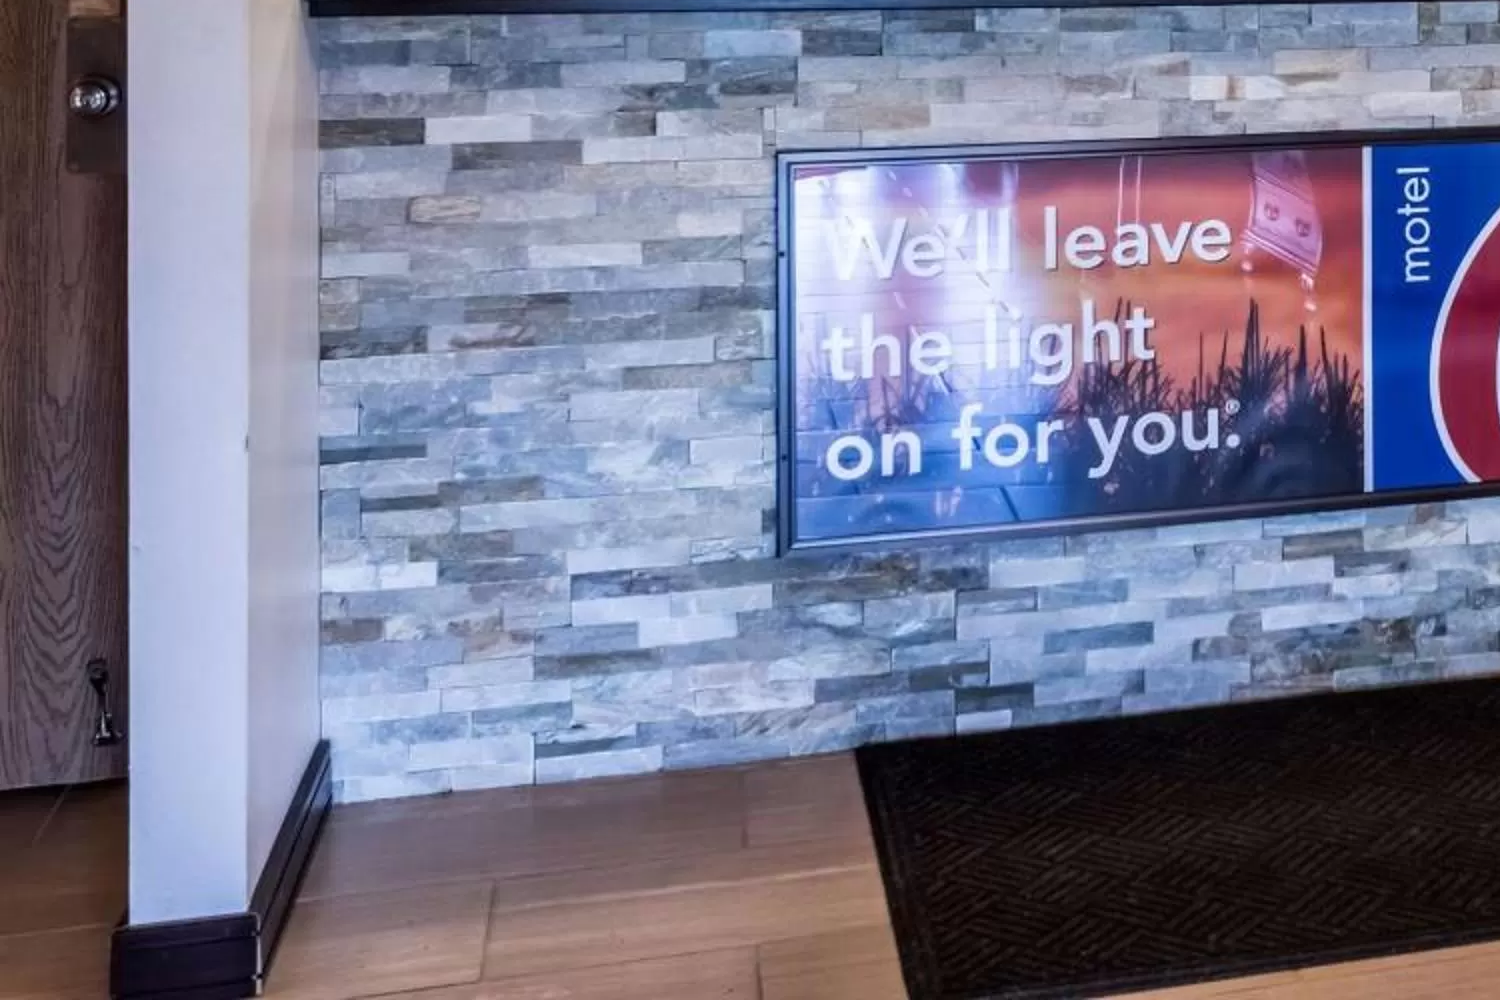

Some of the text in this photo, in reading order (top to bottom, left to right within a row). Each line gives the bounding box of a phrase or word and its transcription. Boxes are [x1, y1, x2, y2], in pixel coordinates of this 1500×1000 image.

[823, 205, 1233, 281] We'll leave
[1396, 166, 1431, 283] motel
[821, 297, 1156, 386] the light
[825, 427, 922, 481] on
[950, 403, 1062, 471] for
